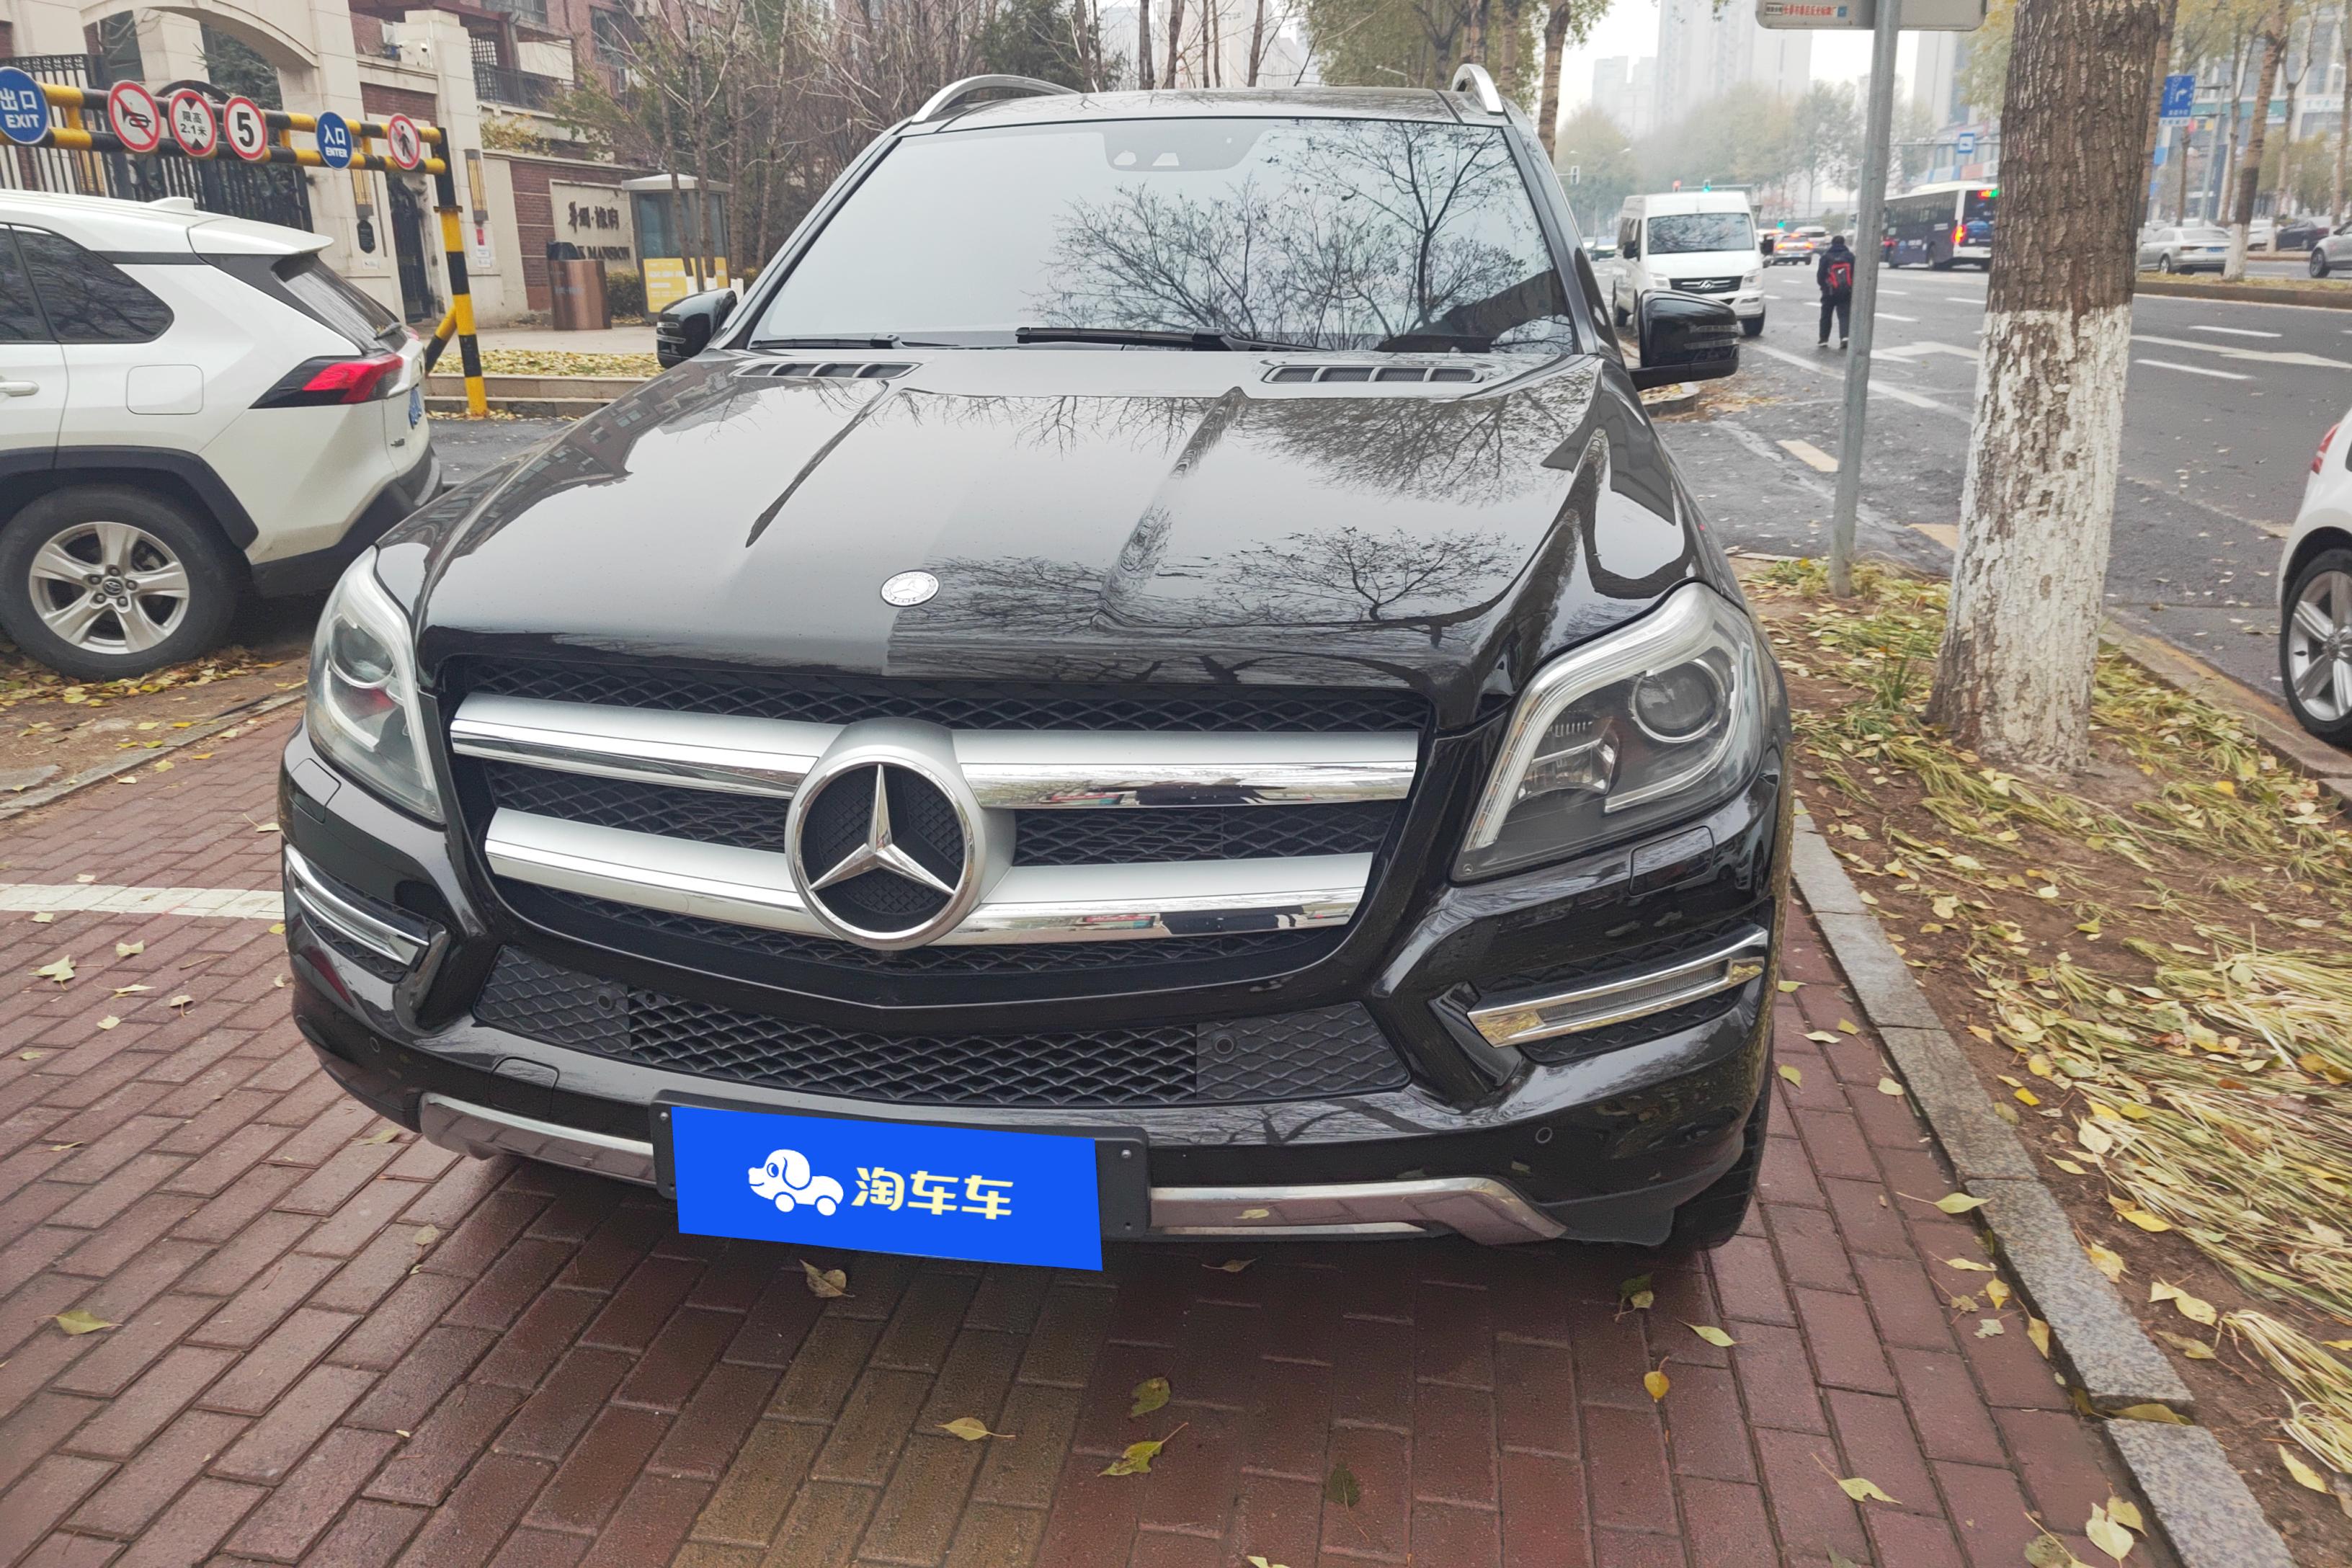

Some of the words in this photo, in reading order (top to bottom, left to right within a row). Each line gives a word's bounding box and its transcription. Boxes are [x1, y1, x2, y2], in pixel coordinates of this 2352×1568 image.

[0, 87, 37, 111] 出口
[4, 114, 40, 128] EXIT
[182, 111, 202, 124] 限高
[179, 123, 208, 137] 2.1米
[236, 111, 254, 148] 5
[324, 124, 347, 146] 入口
[325, 146, 349, 158] ENTER
